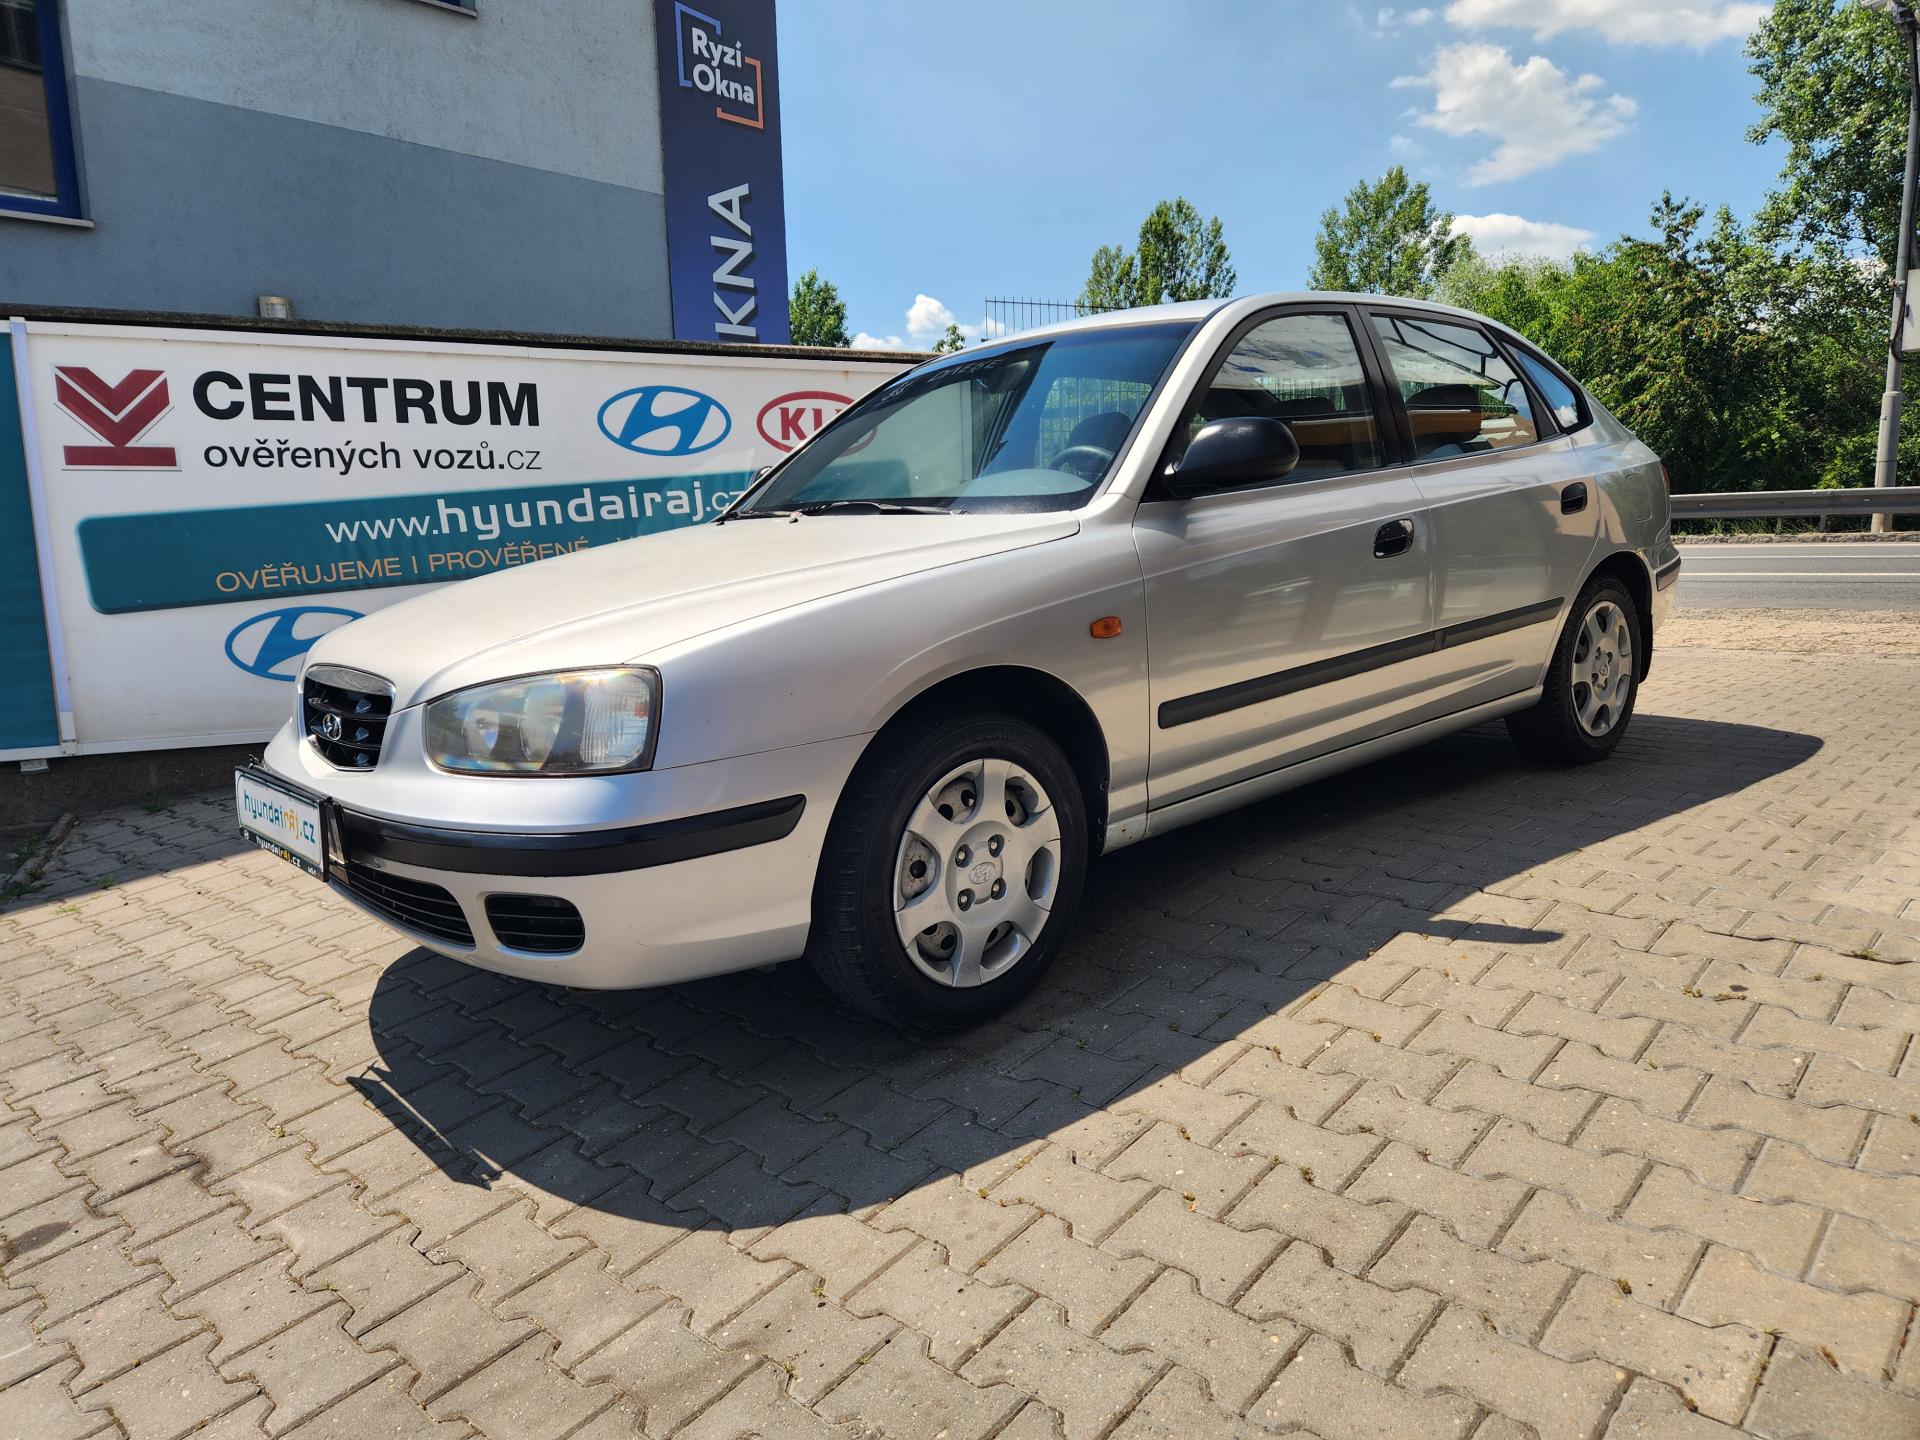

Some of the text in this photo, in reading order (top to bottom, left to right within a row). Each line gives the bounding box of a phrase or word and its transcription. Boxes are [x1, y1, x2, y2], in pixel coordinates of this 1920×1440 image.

[691, 26, 742, 69] Ryzi
[692, 62, 754, 105] Okna
[192, 370, 540, 427] CENTRUM
[779, 406, 843, 441] KI
[203, 438, 542, 476] ověřených vozů.cz
[215, 556, 402, 593] OVĚŘUJEME
